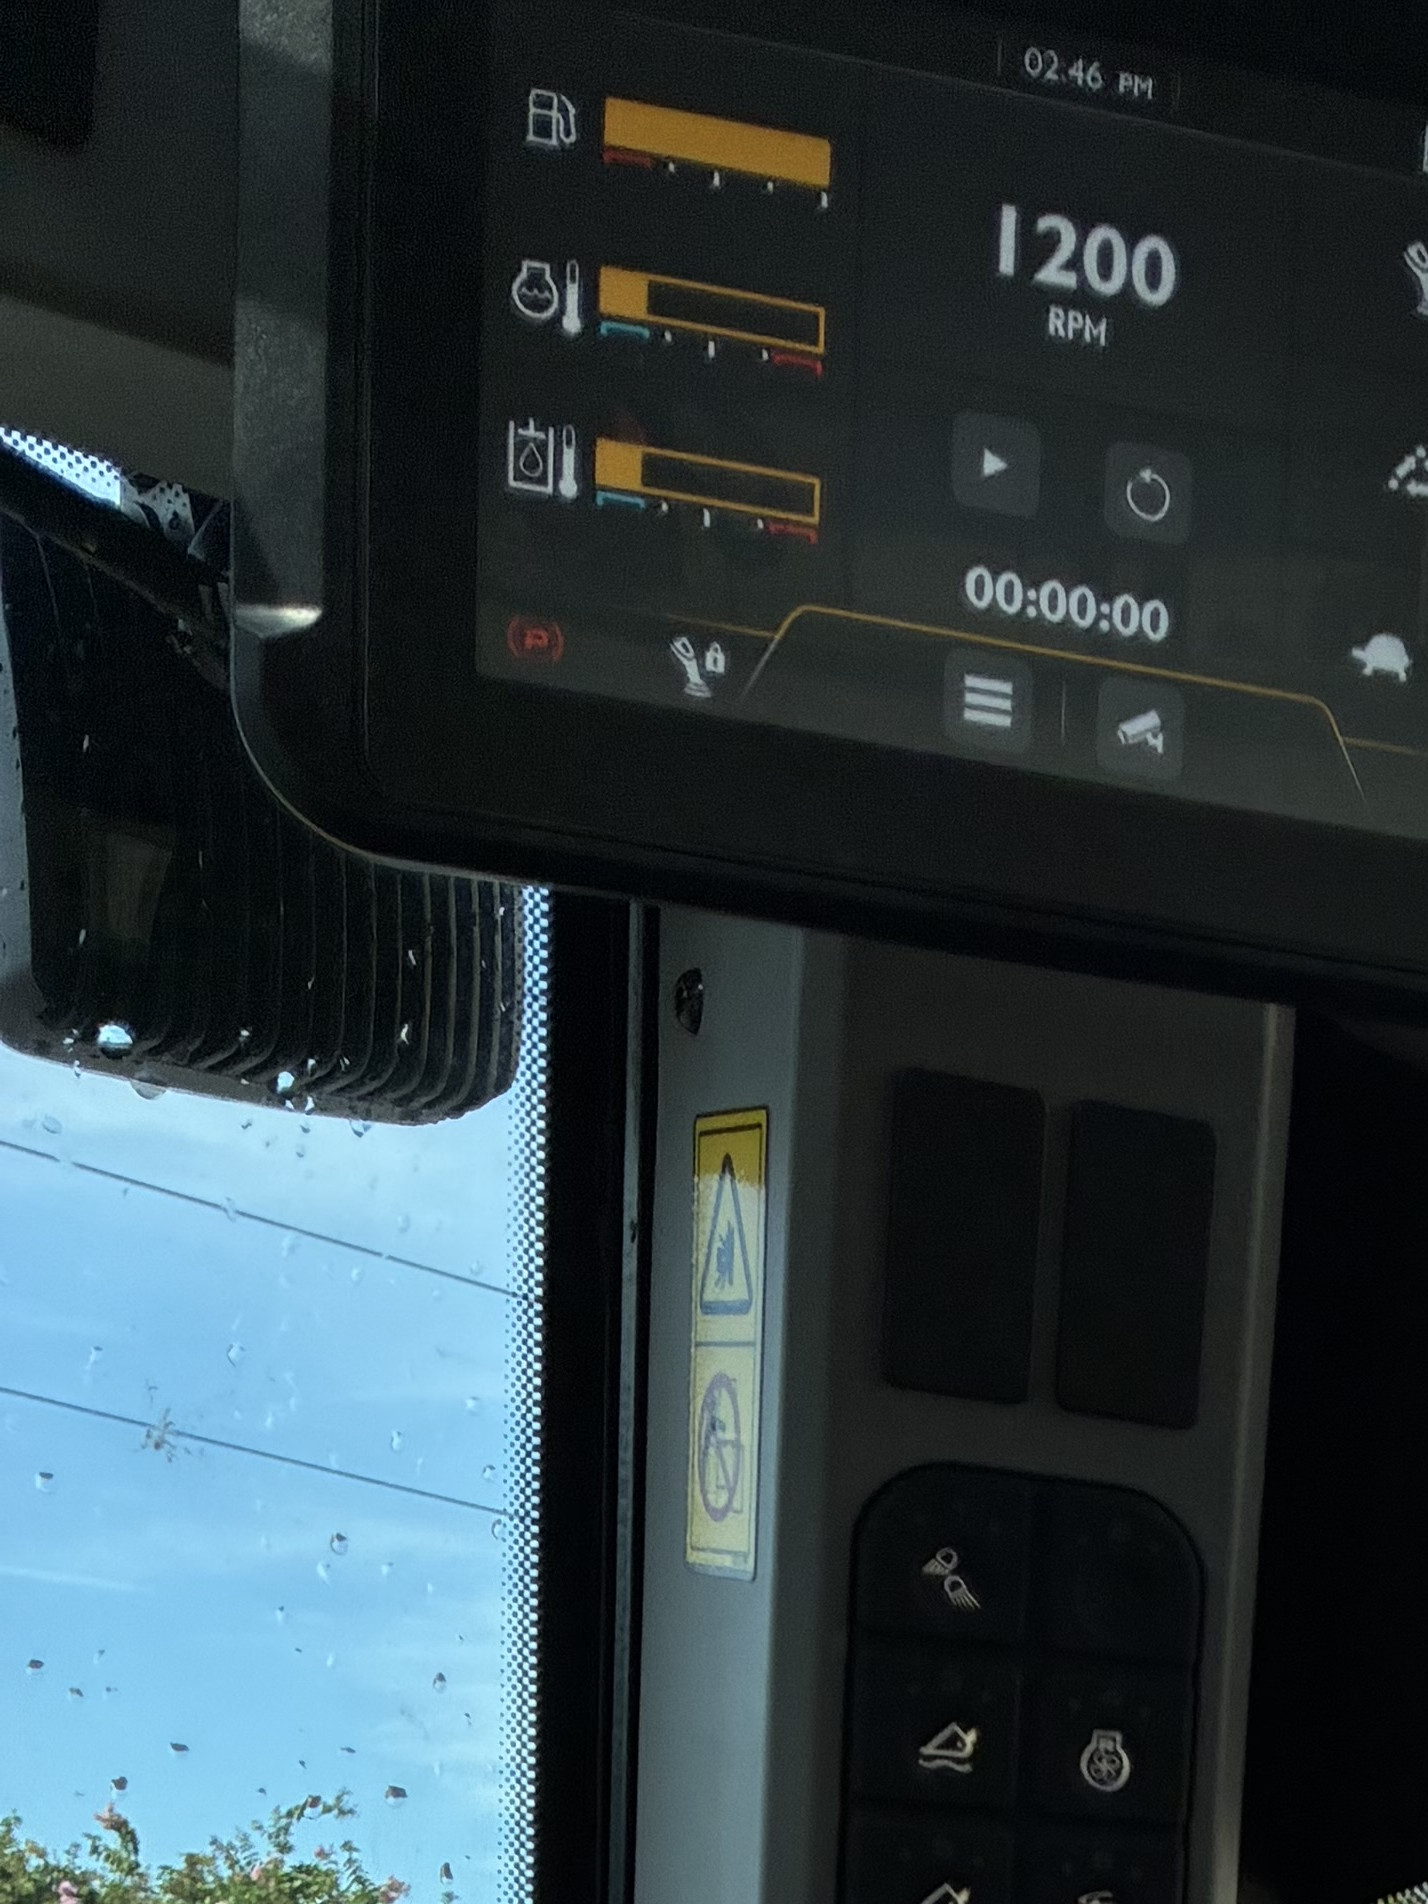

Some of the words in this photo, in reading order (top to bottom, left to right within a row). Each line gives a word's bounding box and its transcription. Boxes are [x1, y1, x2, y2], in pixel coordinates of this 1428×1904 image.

[1117, 70, 1154, 100] PM
[997, 202, 1178, 308] 1200
[1047, 303, 1108, 348] RPM
[964, 564, 1170, 643] 00:00:00
